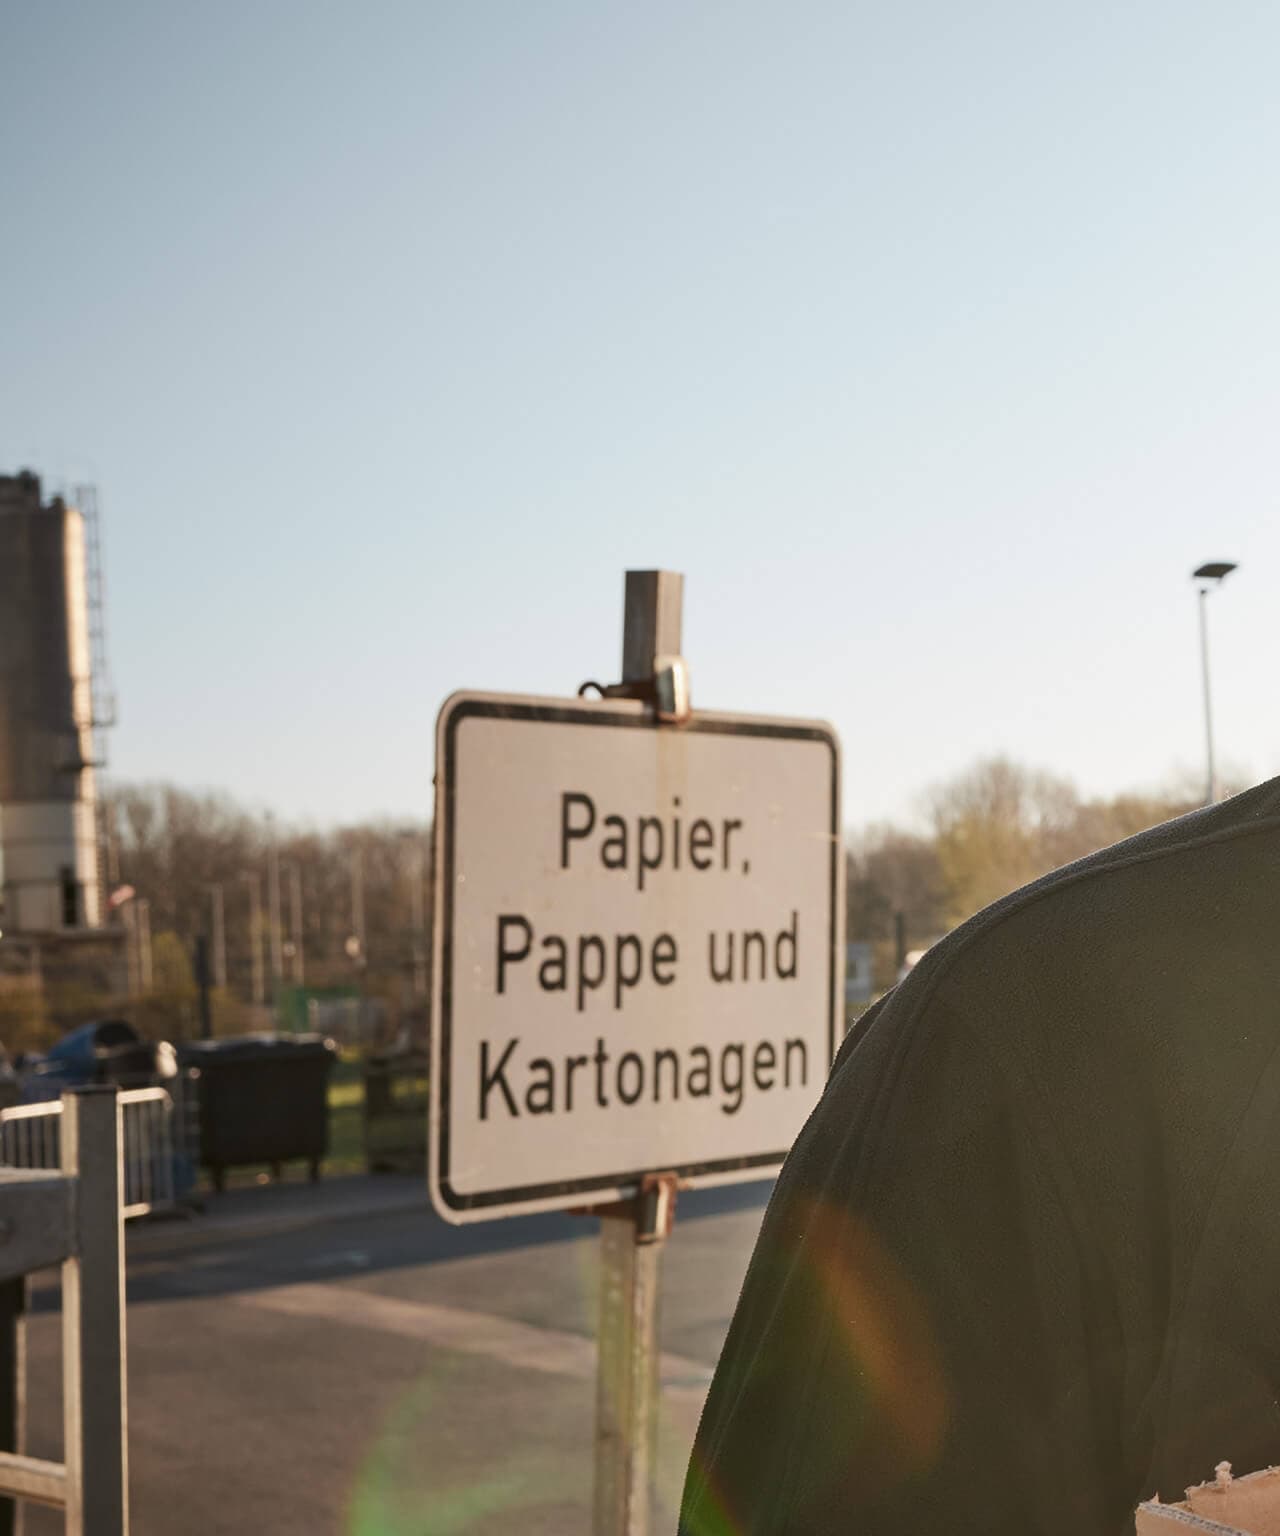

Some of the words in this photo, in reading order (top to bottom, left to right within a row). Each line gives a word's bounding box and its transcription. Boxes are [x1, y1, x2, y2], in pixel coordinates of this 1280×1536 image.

[560, 792, 751, 891] Papier,
[496, 914, 678, 1012] Pappe
[708, 909, 799, 984] und
[479, 1036, 809, 1122] Kartonagen
